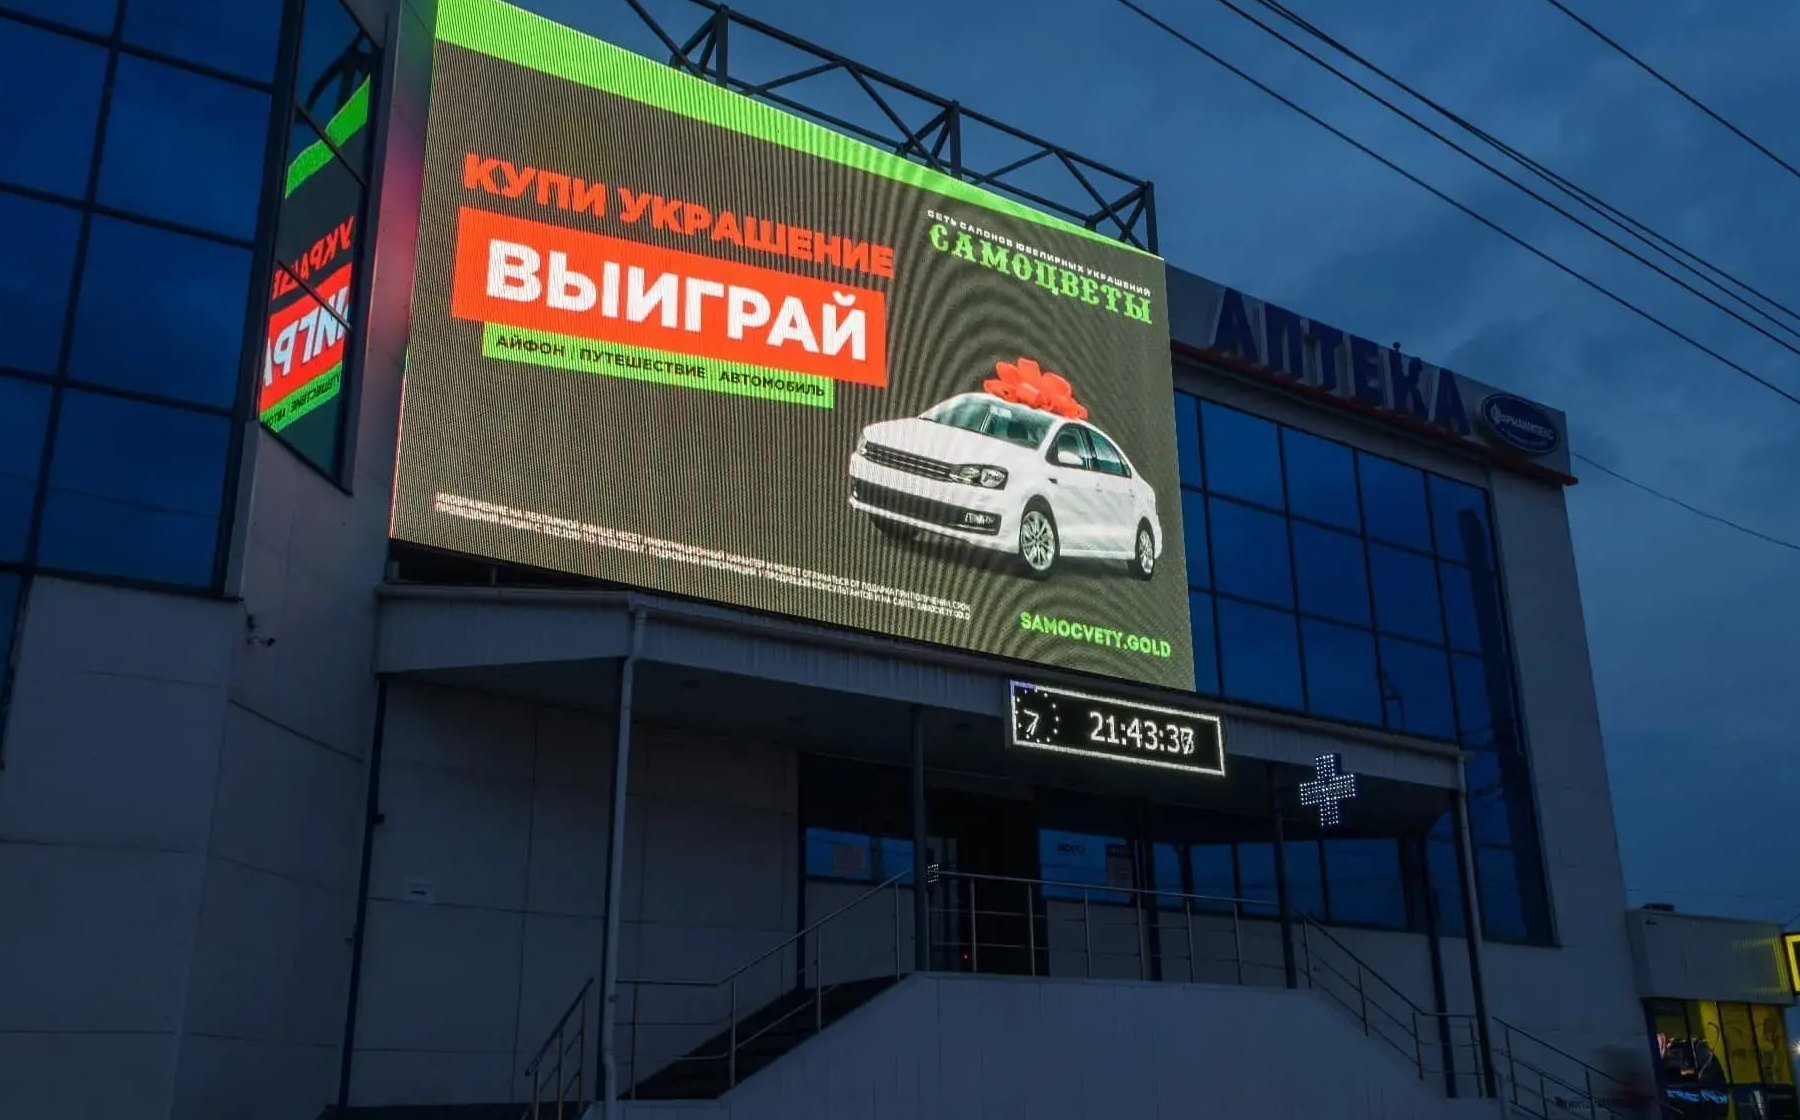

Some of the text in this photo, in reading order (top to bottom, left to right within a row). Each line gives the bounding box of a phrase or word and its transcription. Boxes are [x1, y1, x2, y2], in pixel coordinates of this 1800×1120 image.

[462, 153, 894, 278] КУПИ УКРАШЕНИЕ
[927, 209, 1151, 297] СЕТЬ САЛОНОВ ЮВЕЛИРНЫХ УКРАШЕНИЙ
[486, 238, 867, 361] ВЫИГРАЙ
[928, 223, 1152, 325] САМОЦВЕТЫ
[496, 334, 826, 398] АЙФОН ПУТЕШЕСТВИЕ АВТОМОБИЛЬ
[1211, 287, 1472, 436] АПТЕКА
[1020, 611, 1172, 658] SAMOCVETY.GOLD
